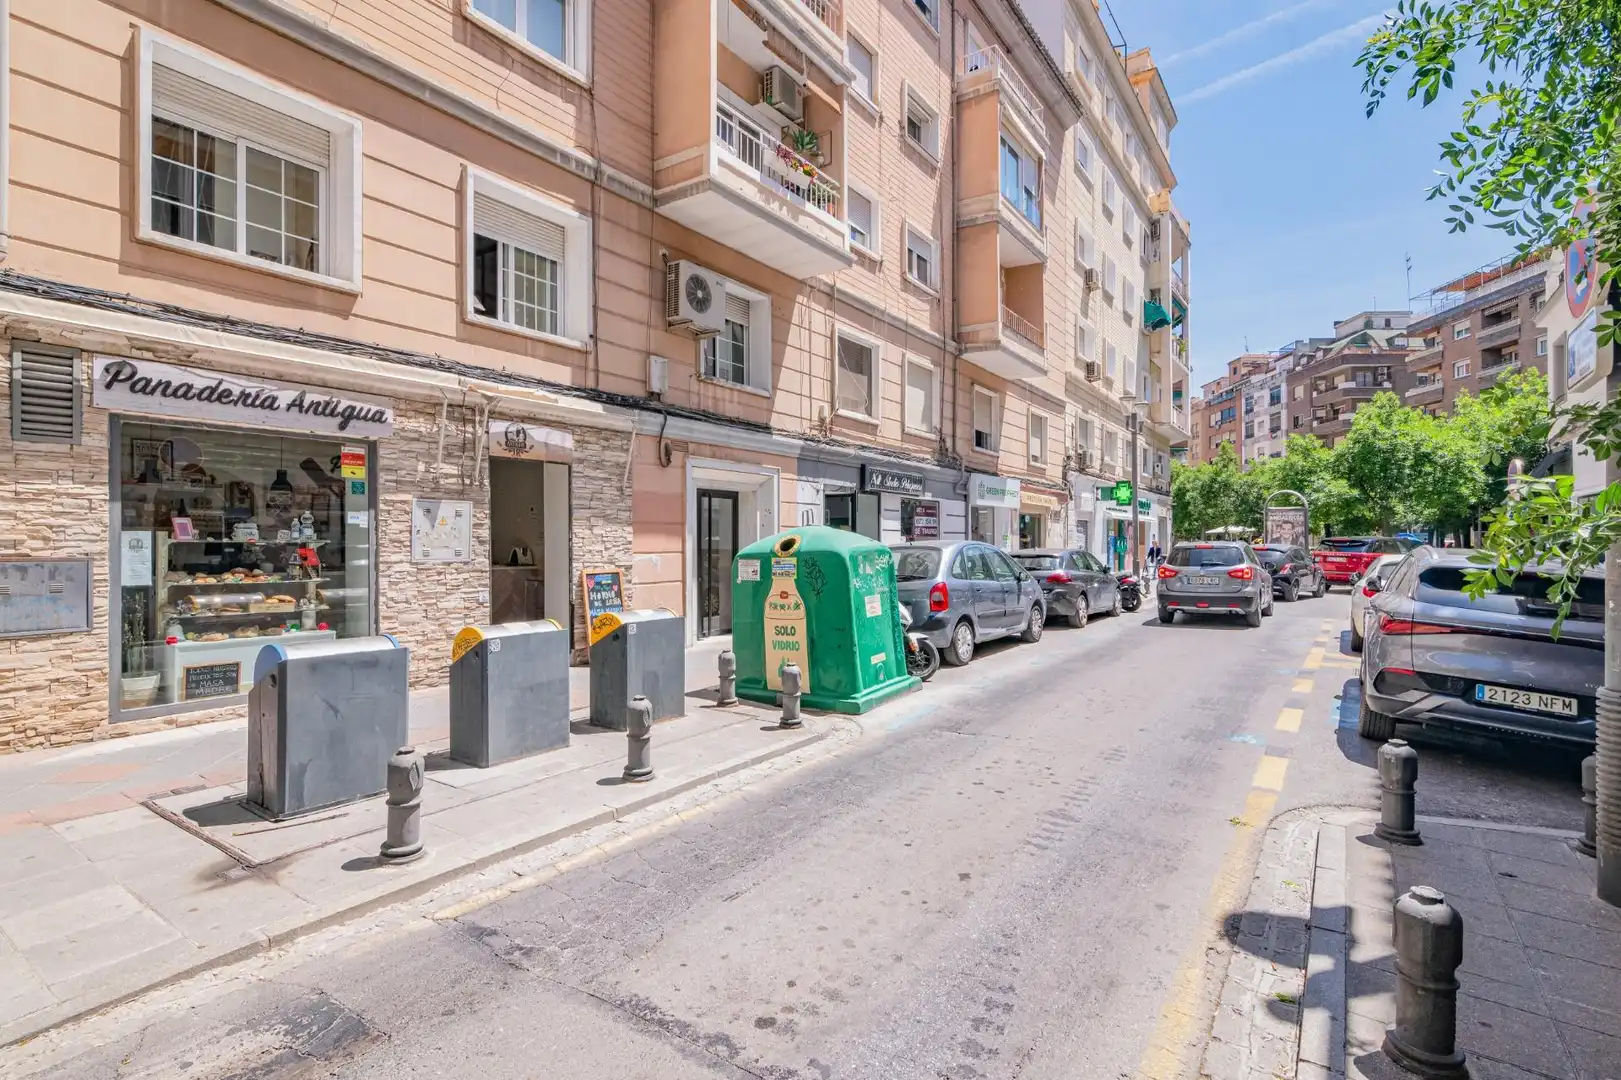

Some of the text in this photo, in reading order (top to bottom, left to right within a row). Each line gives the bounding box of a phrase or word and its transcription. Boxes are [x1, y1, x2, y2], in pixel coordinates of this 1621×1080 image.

[103, 360, 388, 431] Panadería Antigua
[590, 590, 616, 600] HORNO
[774, 625, 796, 636] SOLO
[771, 640, 800, 651] VIDRIO
[200, 680, 224, 689] MASA
[195, 686, 232, 696] MADRE
[1488, 688, 1572, 712] 2123 NFM
